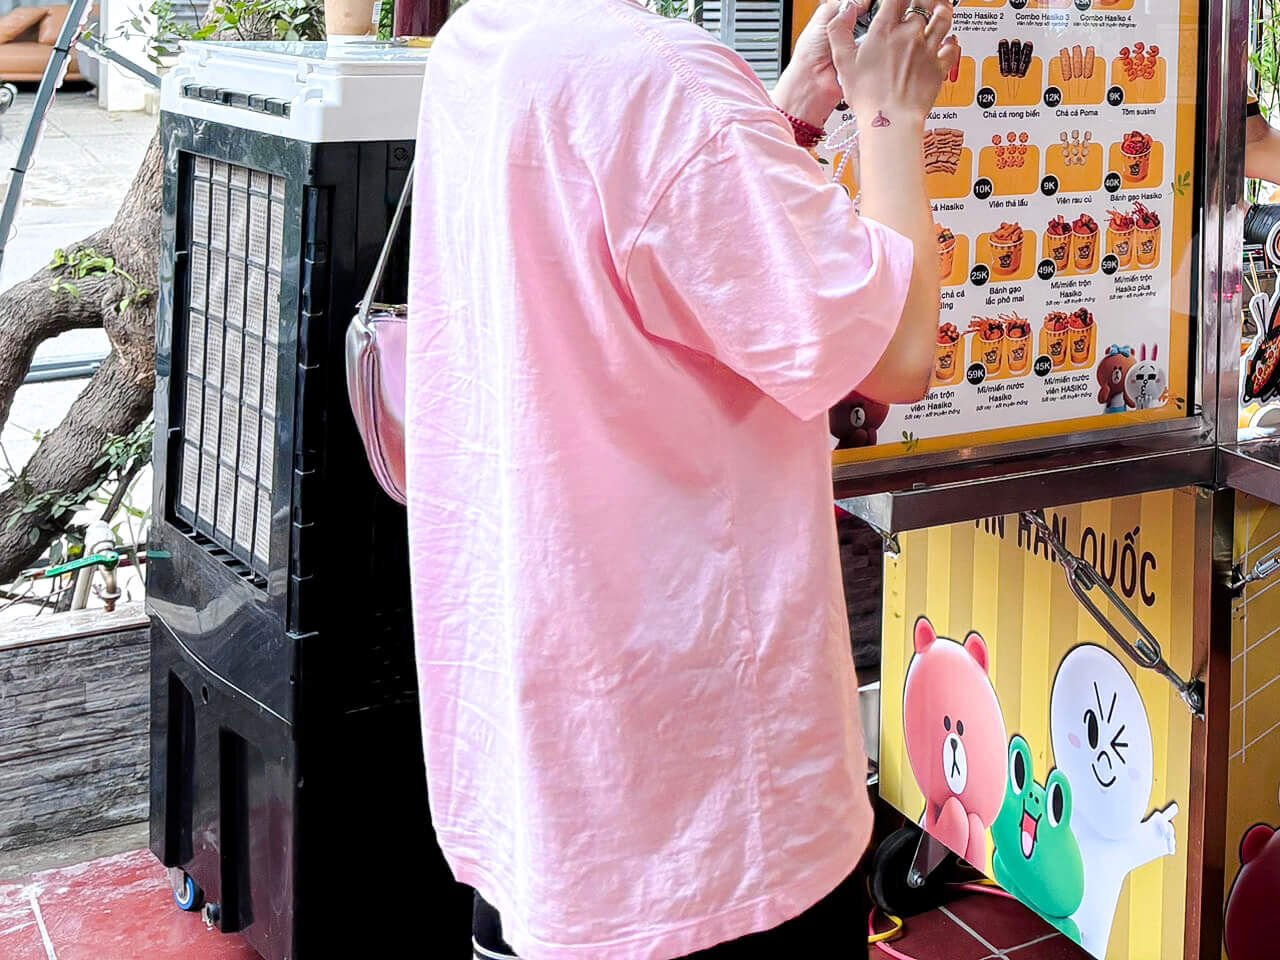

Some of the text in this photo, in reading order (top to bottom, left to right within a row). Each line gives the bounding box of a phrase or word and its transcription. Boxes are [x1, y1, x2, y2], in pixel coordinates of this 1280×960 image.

[952, 11, 1005, 20] ombo Hasiko 2
[1015, 12, 1040, 21] Combo
[1079, 14, 1104, 22] Combo
[1105, 14, 1127, 22] Hasiko
[978, 93, 994, 103] 12K
[1045, 92, 1060, 102] 12K
[1109, 91, 1121, 101] 9K
[942, 111, 958, 120] xích
[983, 109, 1040, 120] Chả cá rong biển
[1055, 108, 1099, 117] Chả cá Poma
[1043, 181, 1056, 191] 9K
[1104, 178, 1121, 188] 40K
[975, 185, 991, 195] 10K
[1056, 196, 1071, 204] Viên
[1083, 194, 1093, 203] củ
[1110, 192, 1127, 202] Bánh
[1141, 192, 1163, 201] Hasiko
[939, 202, 965, 211] Hasiko
[988, 200, 1004, 209] Viên
[1038, 265, 1054, 275] 49K
[1102, 260, 1118, 270] 59K
[971, 271, 988, 280] 25K
[955, 288, 966, 298] cá
[989, 285, 1022, 295] Bánh gạo
[1059, 290, 1083, 299] Hasiko
[1011, 294, 1025, 303] mai
[1035, 360, 1051, 371] 45K
[967, 369, 984, 379] 59K
[1061, 383, 1088, 393] HASIKO
[940, 390, 955, 400] trộn
[988, 393, 1013, 402] Hasiko
[927, 401, 953, 411] Hasiko
[1080, 525, 1158, 607] QUỐC
